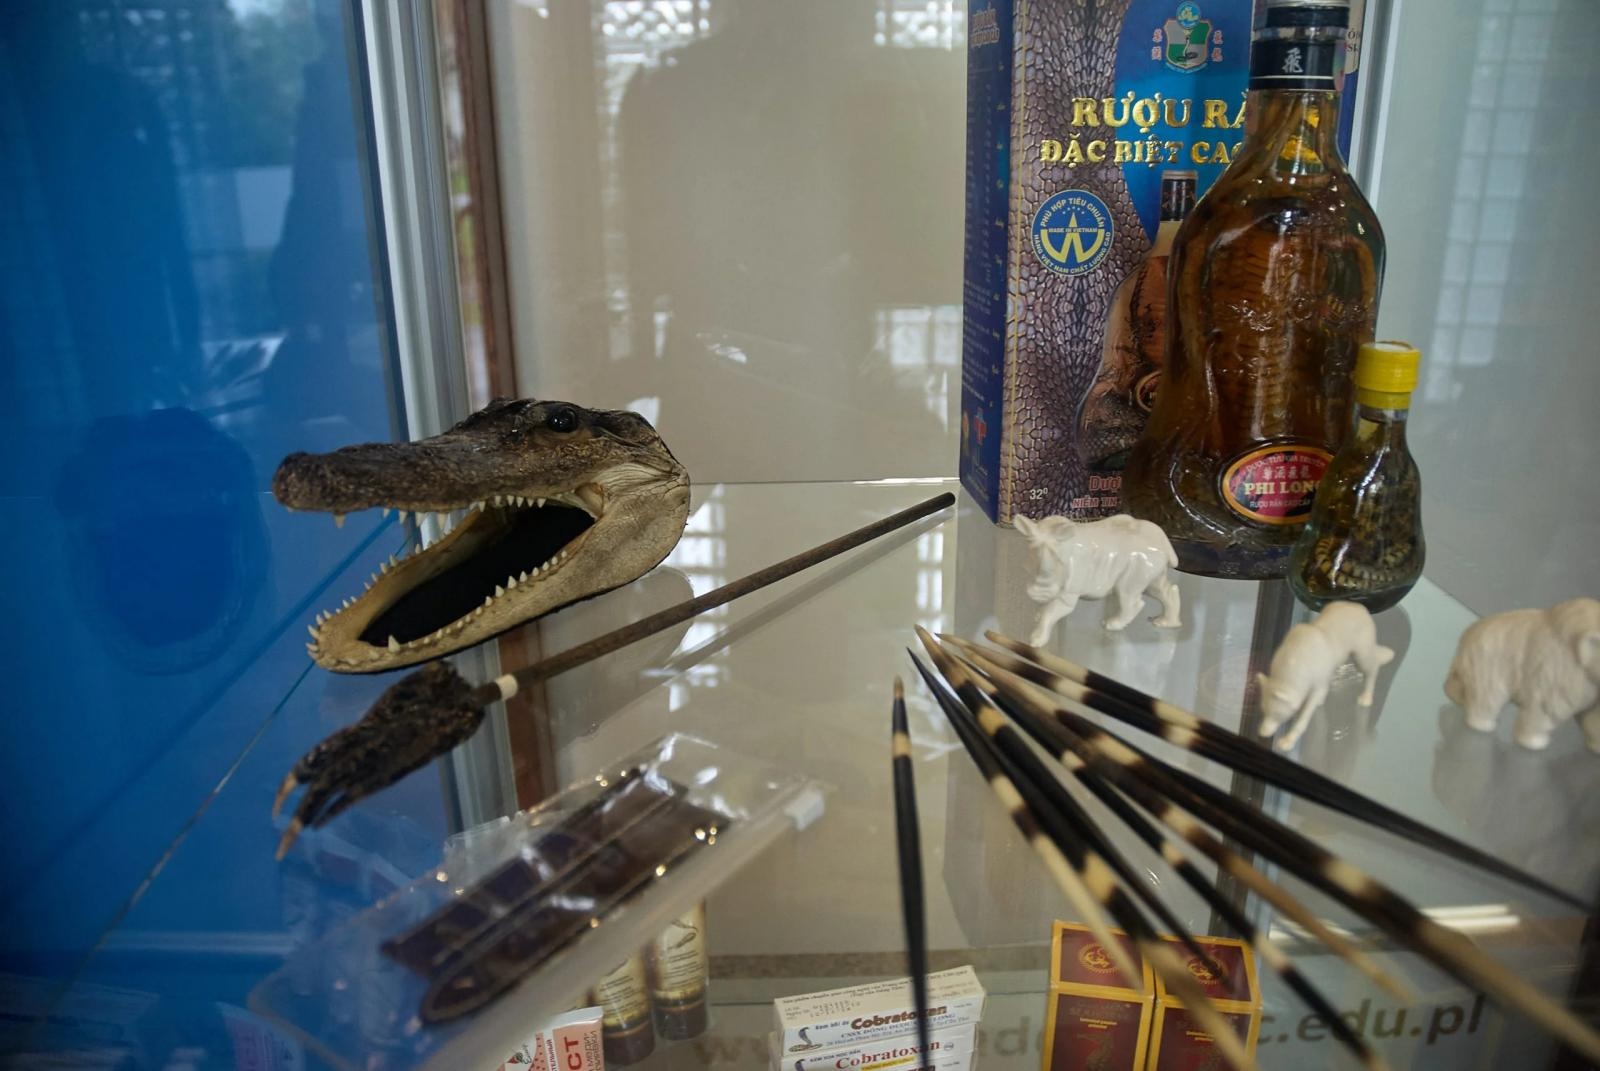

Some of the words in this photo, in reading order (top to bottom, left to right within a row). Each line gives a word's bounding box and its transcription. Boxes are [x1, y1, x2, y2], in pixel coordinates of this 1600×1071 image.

[1071, 91, 1192, 133] RƯỢU
[1040, 133, 1107, 168] ĐẶC
[1114, 134, 1184, 168] BIỆT
[1244, 482, 1275, 495] PHI
[851, 1006, 947, 1030] Cobratoan
[836, 1041, 940, 1069] Cobratoxn
